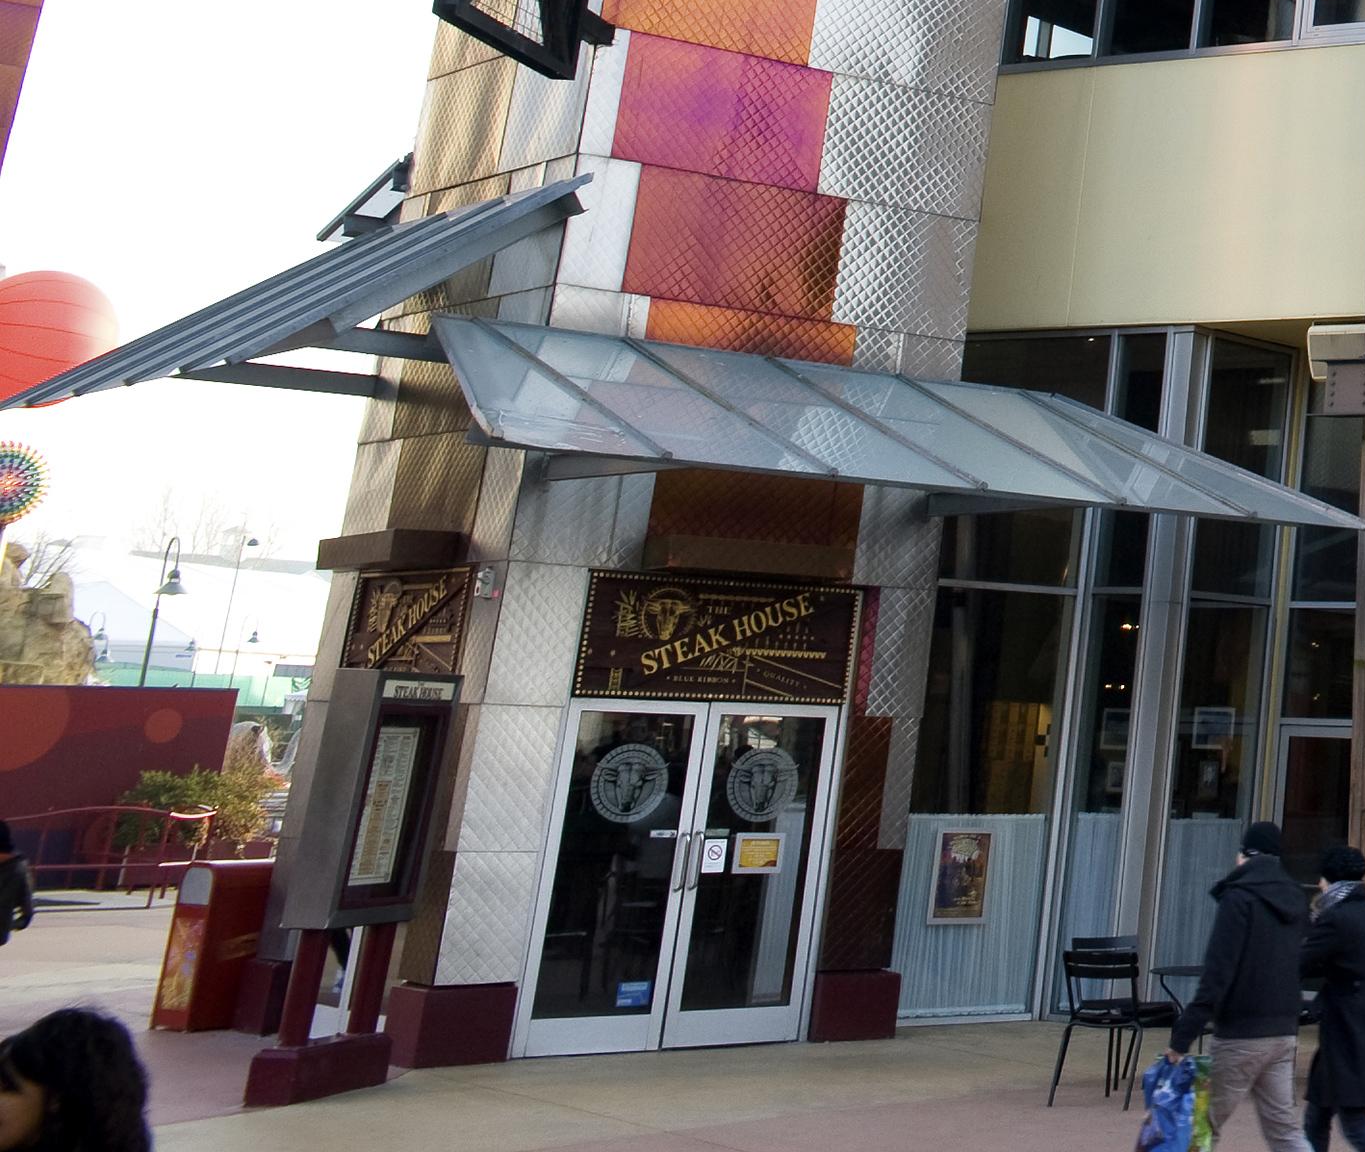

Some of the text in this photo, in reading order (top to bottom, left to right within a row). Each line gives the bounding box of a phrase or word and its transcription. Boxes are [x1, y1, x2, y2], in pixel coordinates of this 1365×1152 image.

[367, 574, 448, 669] STEAK HOUSE
[640, 592, 815, 675] STEAK HOUSE
[394, 685, 418, 698] STEAK
[697, 675, 729, 684] RIBBON
